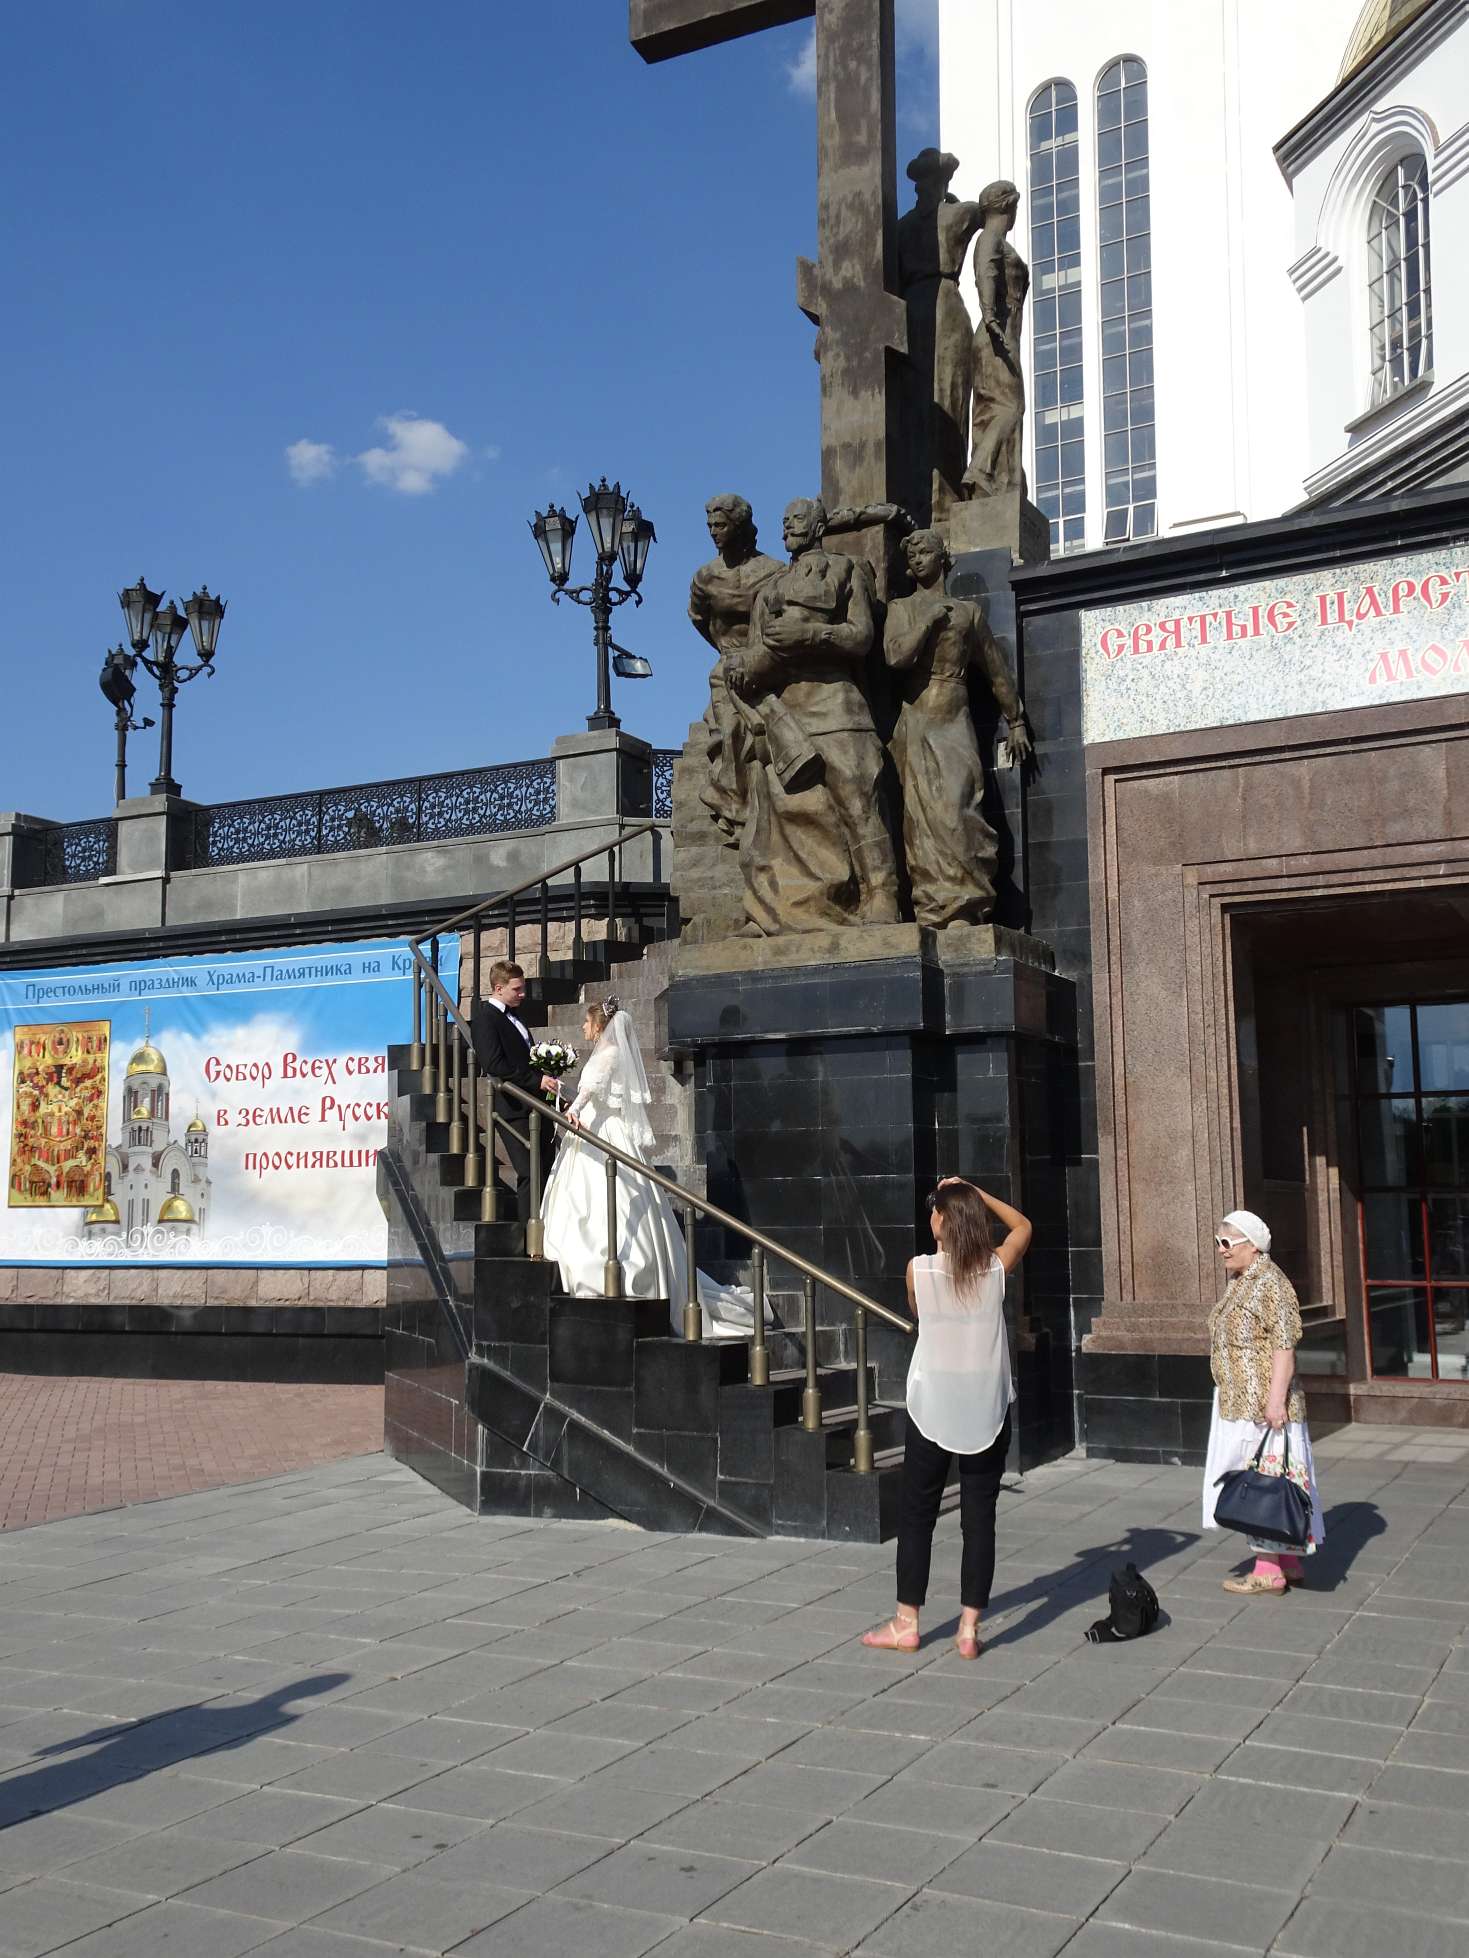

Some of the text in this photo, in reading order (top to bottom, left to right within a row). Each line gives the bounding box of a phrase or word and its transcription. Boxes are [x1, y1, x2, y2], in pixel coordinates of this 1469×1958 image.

[1099, 600, 1298, 660] СВЯТЫЕ
[25, 979, 120, 1003] Престольный
[129, 974, 198, 996] праздник
[205, 962, 353, 991] Храма-Памятника
[362, 960, 381, 974] на
[204, 1056, 272, 1088] Собор
[280, 1052, 337, 1085] Всех
[216, 1108, 229, 1127] в
[236, 1105, 310, 1128] земле
